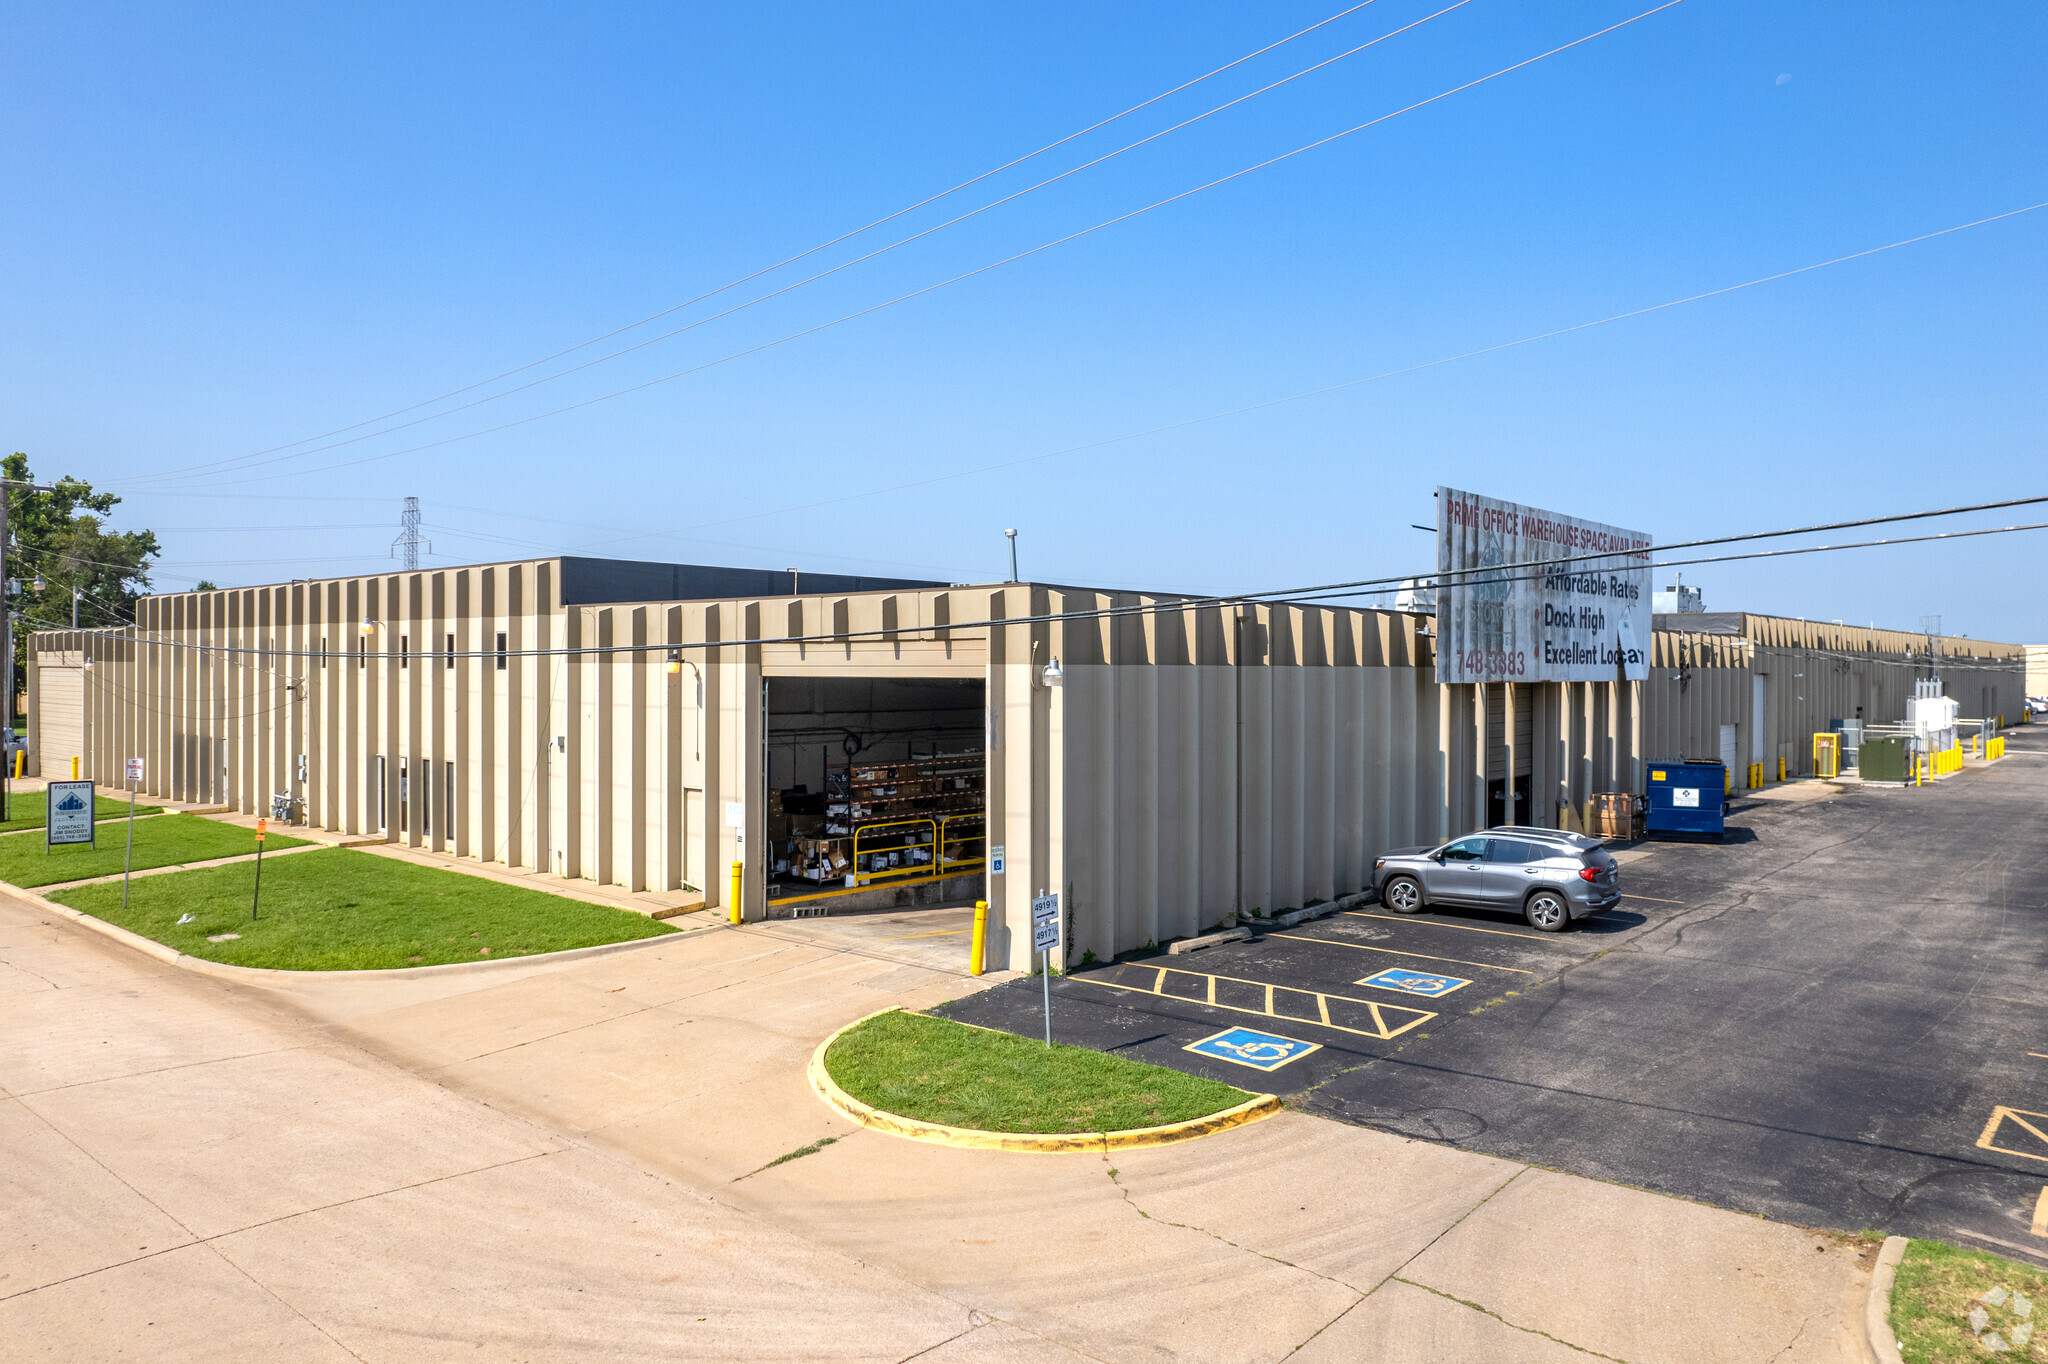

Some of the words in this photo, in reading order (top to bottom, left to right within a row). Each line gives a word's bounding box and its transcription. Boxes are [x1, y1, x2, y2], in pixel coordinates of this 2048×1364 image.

[1447, 499, 1479, 529] PRIME
[1482, 507, 1518, 536] OFFICE
[1521, 515, 1578, 547] WAREHOUSE
[1580, 529, 1608, 552] SPACE
[1609, 535, 1650, 561] AVAILABLE
[1545, 566, 1606, 596] Affordable
[1610, 575, 1639, 600] Rates
[1544, 602, 1575, 629] Dock
[1579, 606, 1605, 637] High
[1457, 649, 1525, 676] 748-3383
[1545, 640, 1597, 665] Excellent
[1034, 900, 1050, 912] 4919
[1036, 930, 1051, 940] 4917
